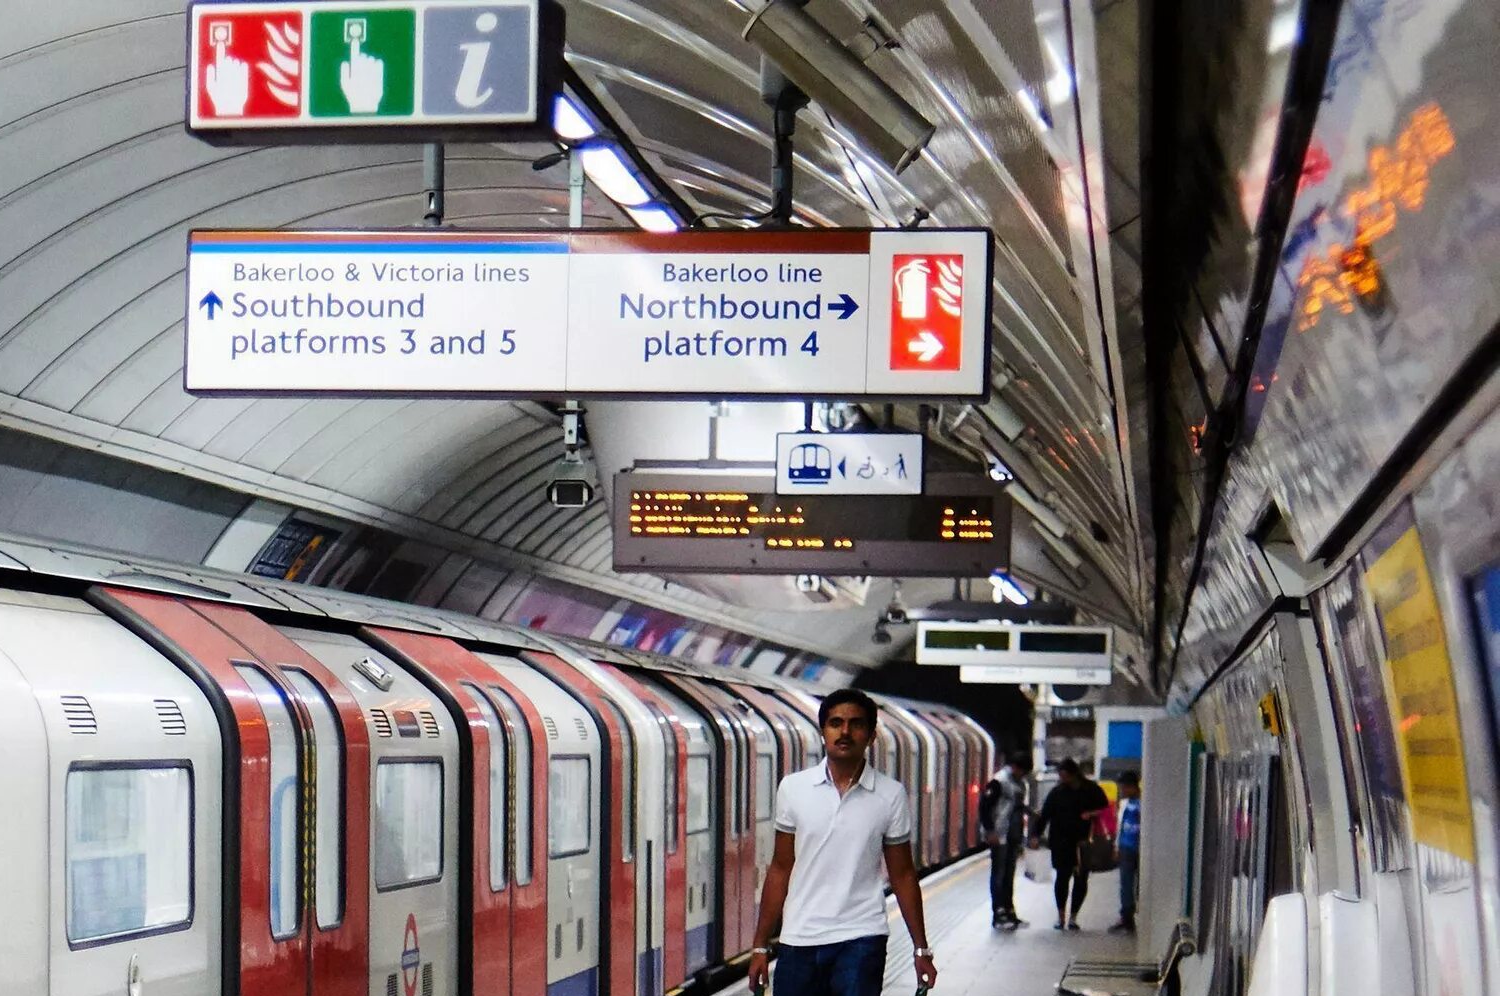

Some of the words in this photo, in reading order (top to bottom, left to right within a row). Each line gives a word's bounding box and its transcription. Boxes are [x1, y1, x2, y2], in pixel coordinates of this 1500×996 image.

[233, 263, 334, 282] Bakerloo
[345, 264, 359, 281] &
[372, 263, 464, 282] Victoria
[474, 263, 530, 283] lines
[662, 262, 769, 284] Bakerloo
[778, 262, 823, 284] line
[232, 293, 424, 319] Southbound
[620, 293, 821, 320] Northbound
[231, 328, 387, 358] platforms
[399, 329, 417, 355] 3
[430, 329, 485, 355] and
[499, 329, 517, 355] 5
[643, 330, 788, 361] platform
[799, 330, 820, 357] 4
